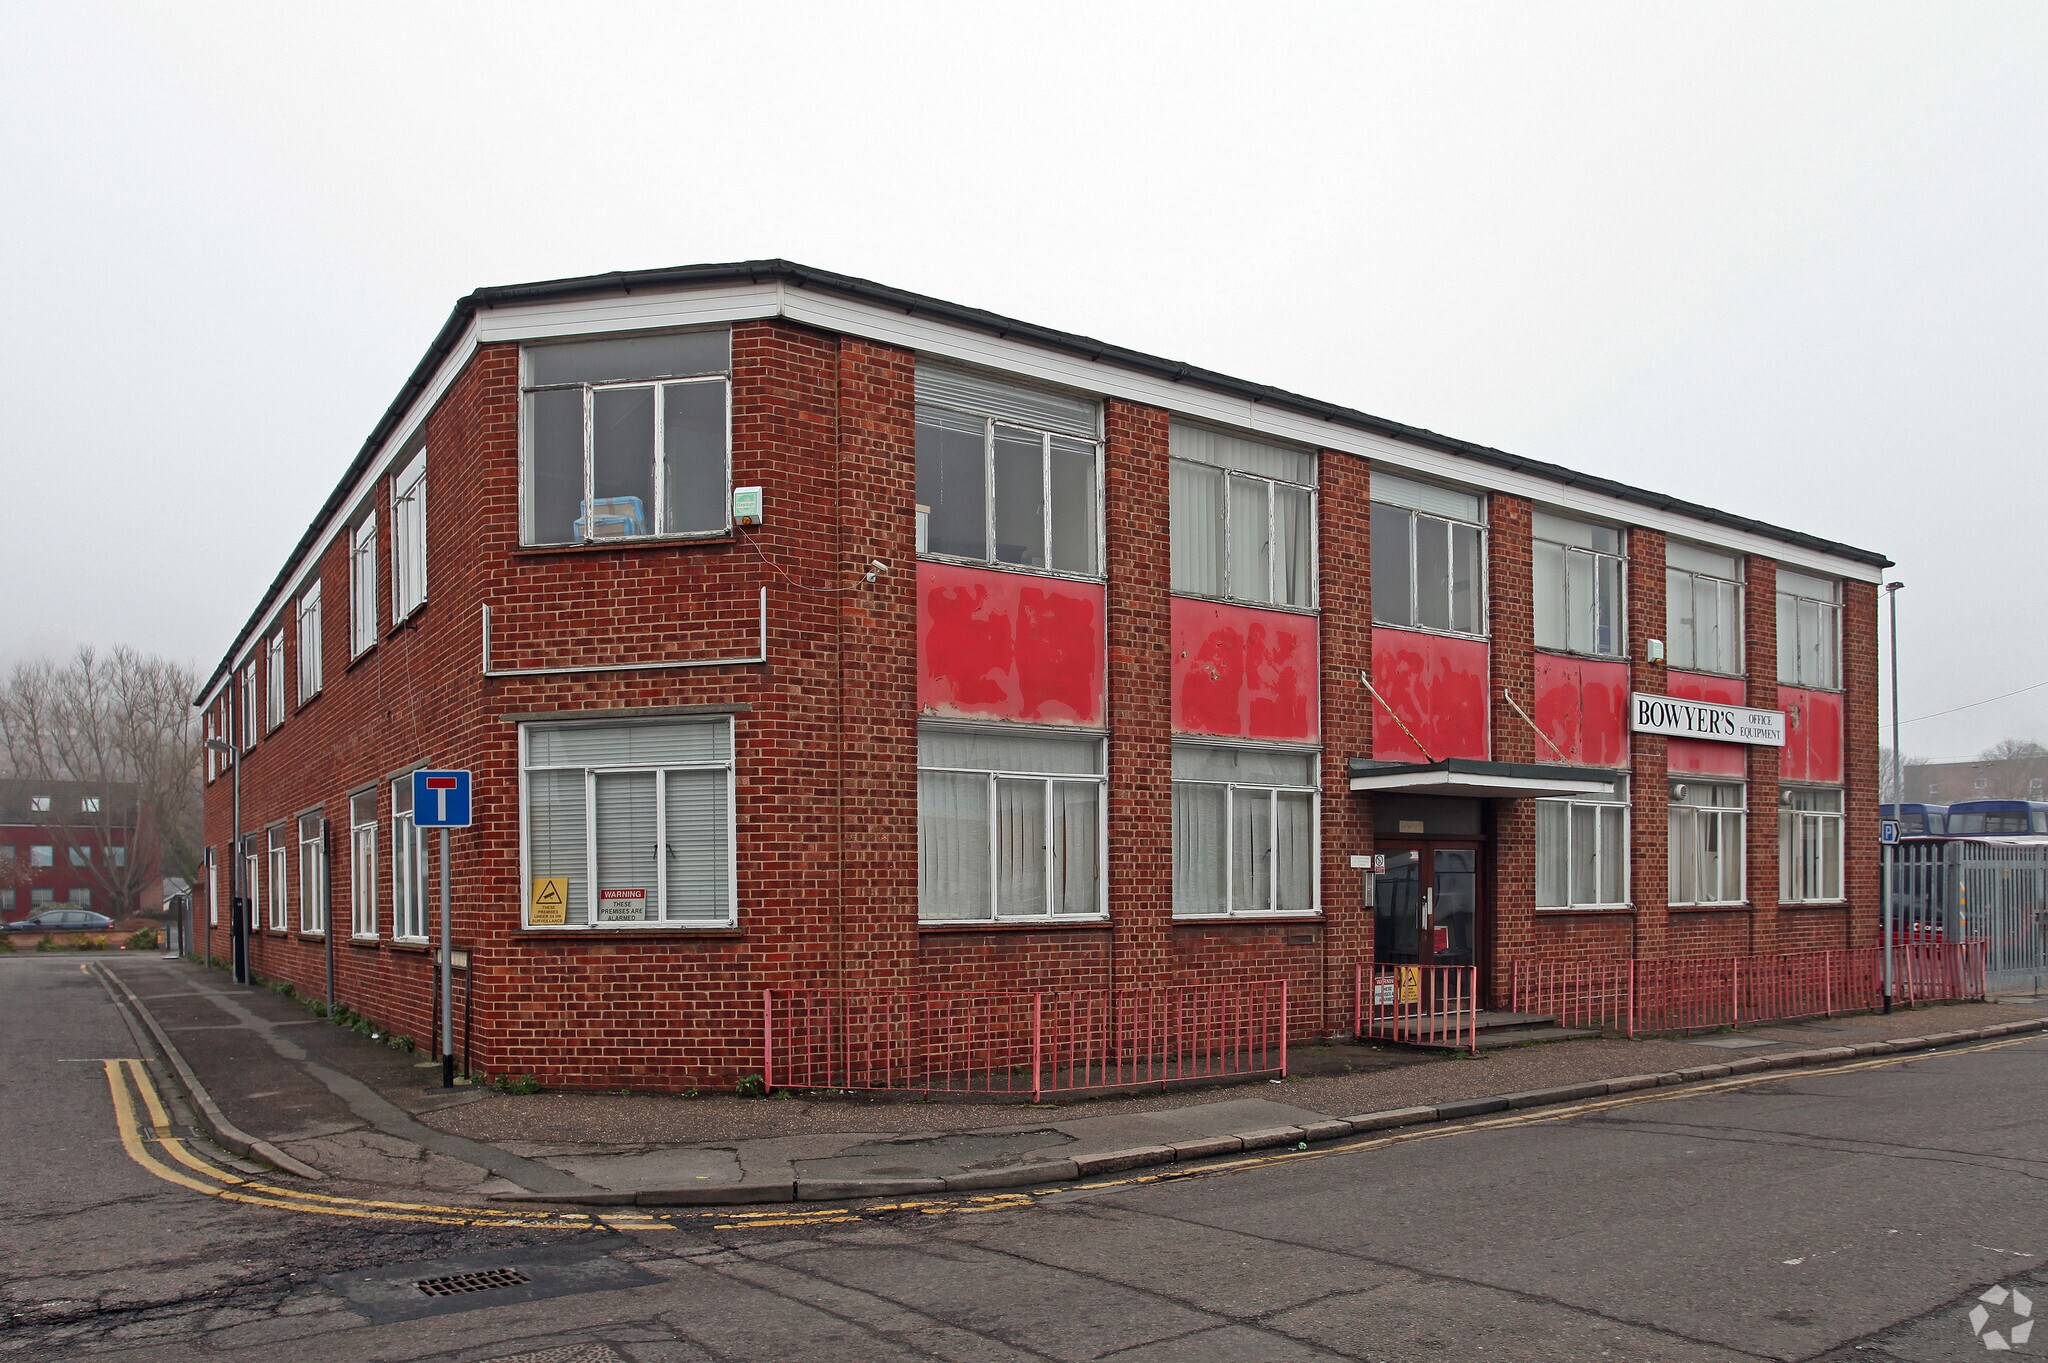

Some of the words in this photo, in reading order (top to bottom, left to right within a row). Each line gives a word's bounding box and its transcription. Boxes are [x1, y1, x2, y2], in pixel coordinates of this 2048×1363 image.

[1637, 699, 1735, 736] BOWYER'S
[1748, 713, 1773, 726] OFFICE
[1740, 726, 1781, 740] EQUIPMENT
[1885, 825, 1892, 840] P
[604, 890, 642, 898] WARNING
